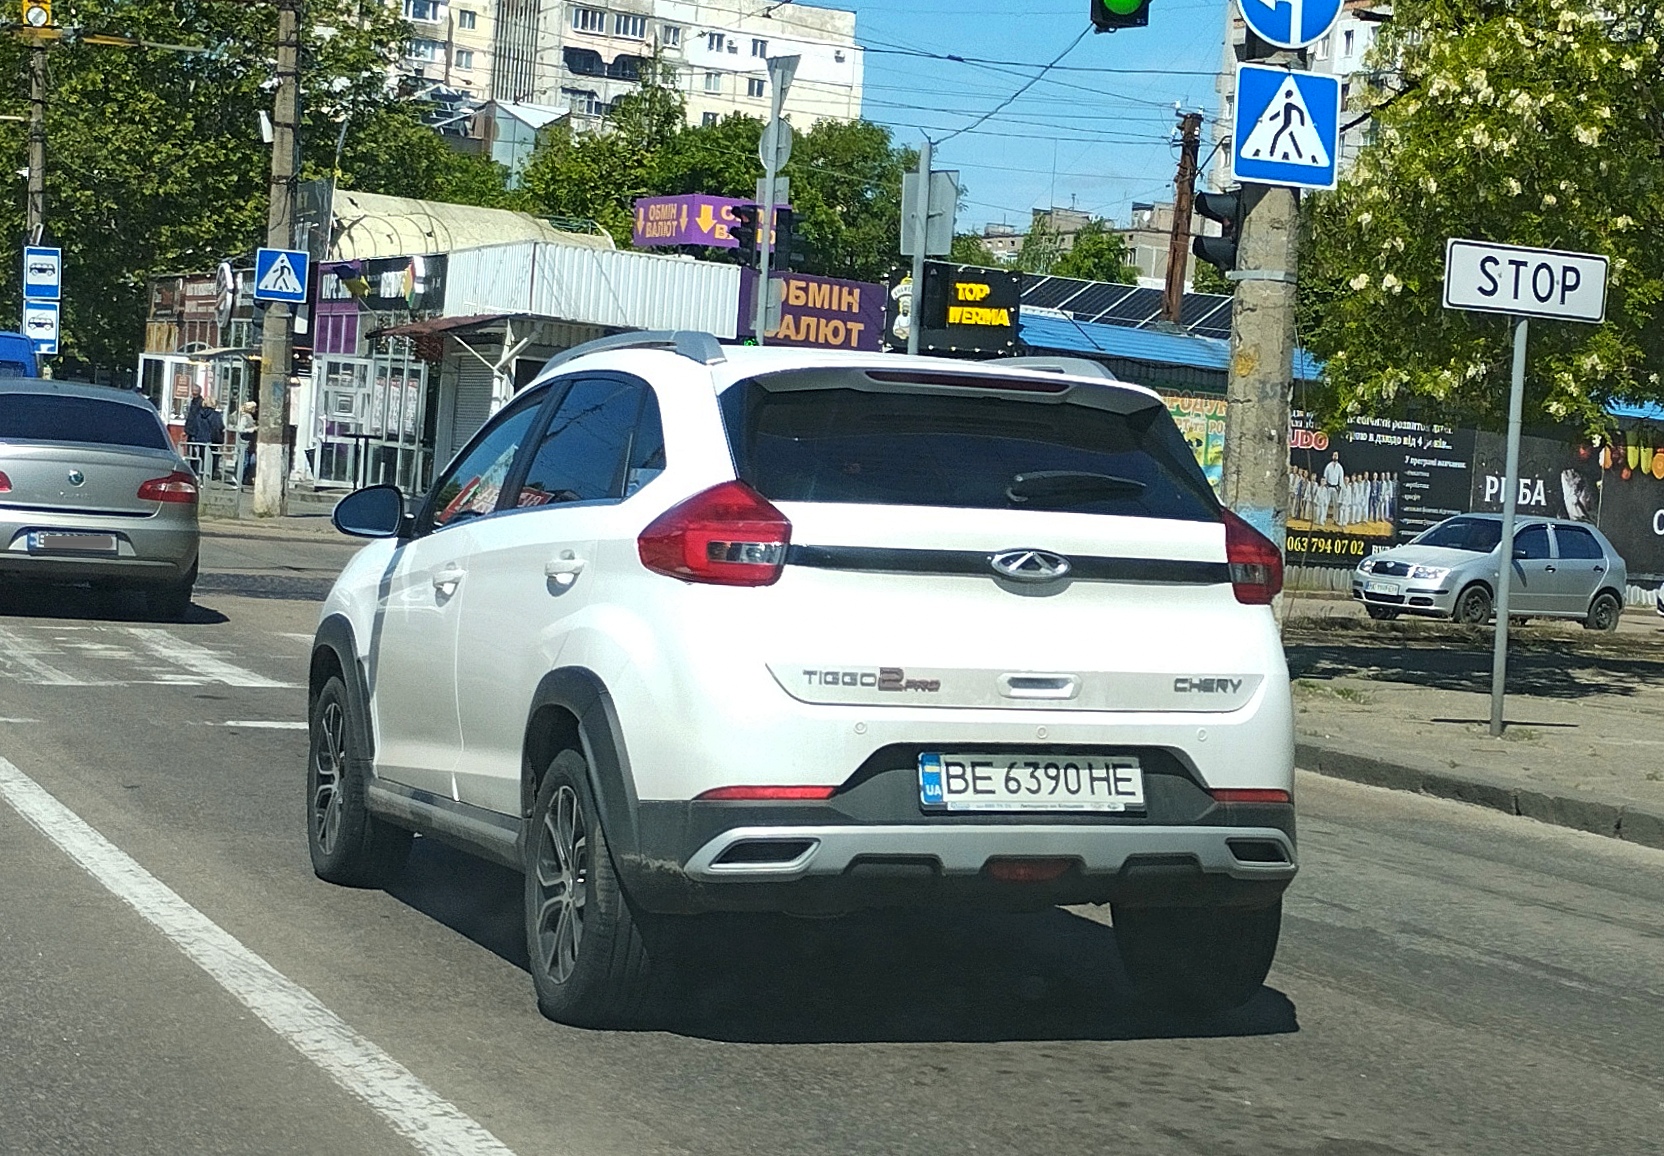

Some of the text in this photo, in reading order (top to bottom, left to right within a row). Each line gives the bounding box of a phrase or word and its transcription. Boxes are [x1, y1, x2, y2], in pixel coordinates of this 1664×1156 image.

[649, 203, 677, 221] ОБМІН
[645, 220, 678, 238] ВАЛЮТ
[1477, 255, 1581, 305] STOP
[781, 278, 860, 313] БМІН
[1287, 536, 1364, 555] 063 794 07 02
[803, 669, 877, 687] TIGGO
[1174, 678, 1243, 694] CHERY
[945, 761, 1137, 796] BE 6390 HE
[926, 784, 942, 796] UA
